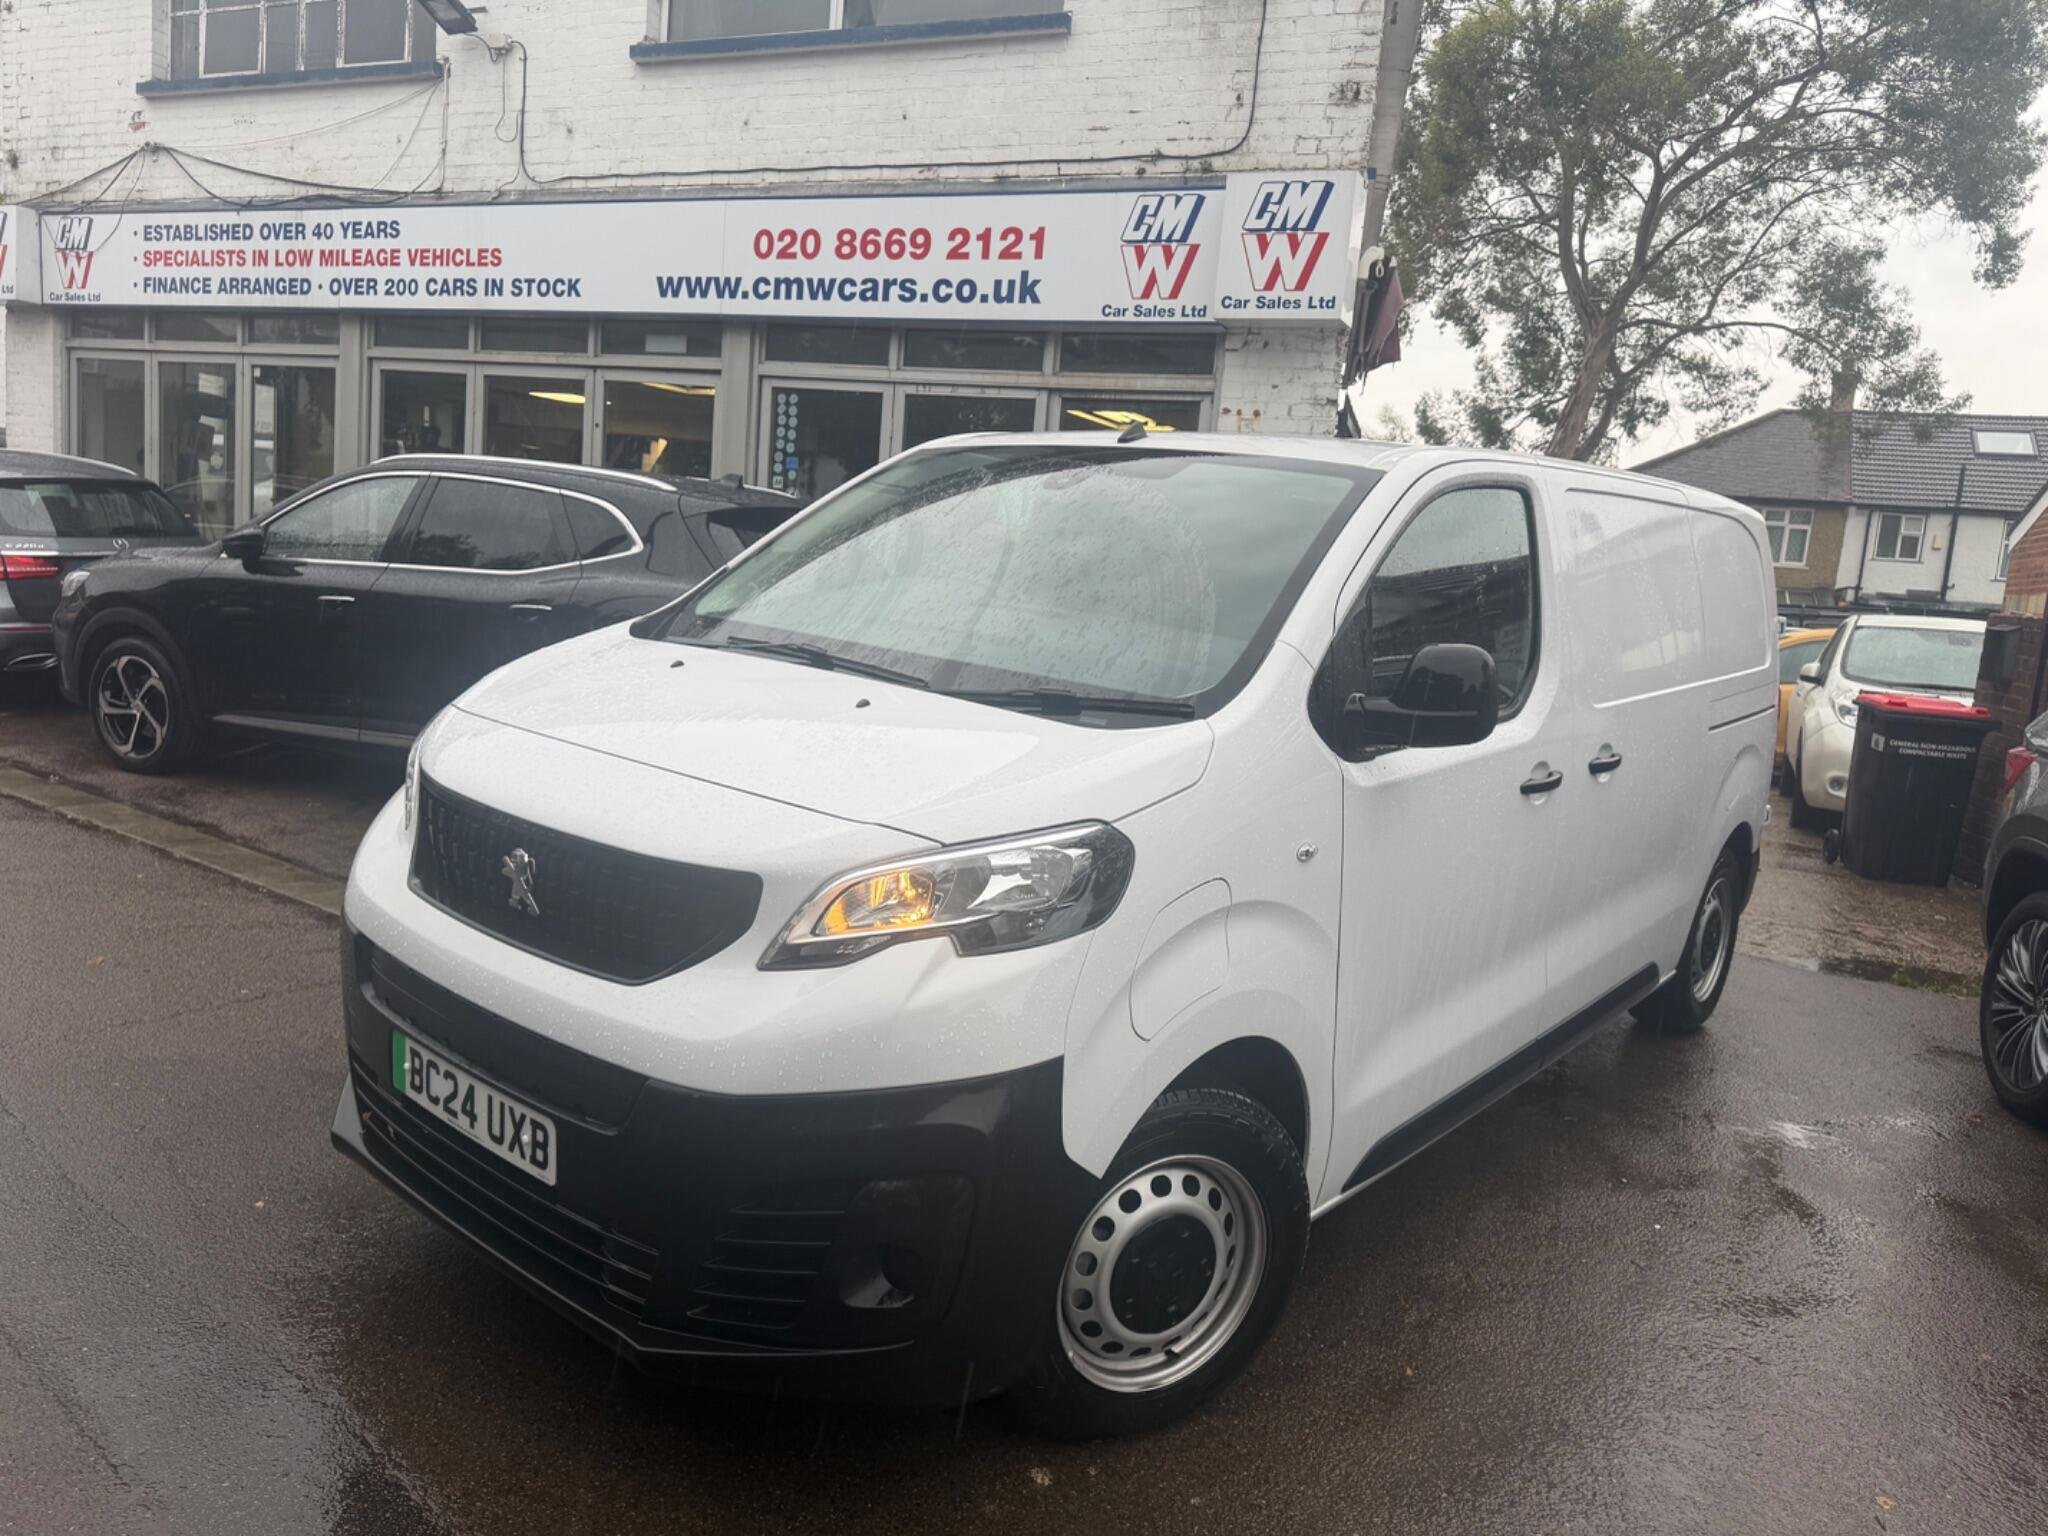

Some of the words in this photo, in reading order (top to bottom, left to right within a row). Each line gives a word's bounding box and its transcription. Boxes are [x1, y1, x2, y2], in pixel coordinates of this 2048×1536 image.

[1121, 193, 1206, 242] CM
[1242, 181, 1335, 231] CM
[55, 216, 94, 250] CM
[143, 223, 254, 242] ESTABLISHED
[259, 222, 307, 241] OVER
[311, 222, 334, 241] 40
[339, 220, 401, 240] YEARS
[753, 228, 822, 261] 020
[834, 227, 932, 261] 8669
[945, 226, 1046, 261] 2121
[55, 250, 95, 289] W
[143, 249, 247, 268] SPECIALISTS
[252, 249, 269, 267] IN
[274, 248, 314, 268] LOW
[319, 248, 401, 268] MILEAGE
[407, 247, 503, 268] VEHICLES
[1120, 244, 1200, 300] W
[1241, 232, 1330, 291] W
[1, 284, 14, 294] Ltd
[49, 291, 63, 302] Car
[64, 291, 86, 302] Sales
[88, 292, 101, 302] Ltd
[143, 276, 212, 296] FINANCE
[217, 277, 312, 297] ARRANGED
[328, 277, 378, 297] OVER
[383, 277, 419, 297] 200
[425, 277, 478, 298] CARS
[484, 277, 504, 298] IN
[510, 277, 582, 299] STOCK
[656, 269, 1042, 305] www.cmwcars.co.uk
[1220, 295, 1251, 309] Car
[1254, 295, 1302, 310] Sales
[1306, 294, 1336, 309] Ltd
[1101, 303, 1129, 318] Car
[1133, 303, 1177, 318] Sales
[1180, 304, 1208, 319] Ltd
[409, 1046, 477, 1131] BC24
[487, 1093, 549, 1172] UXB
